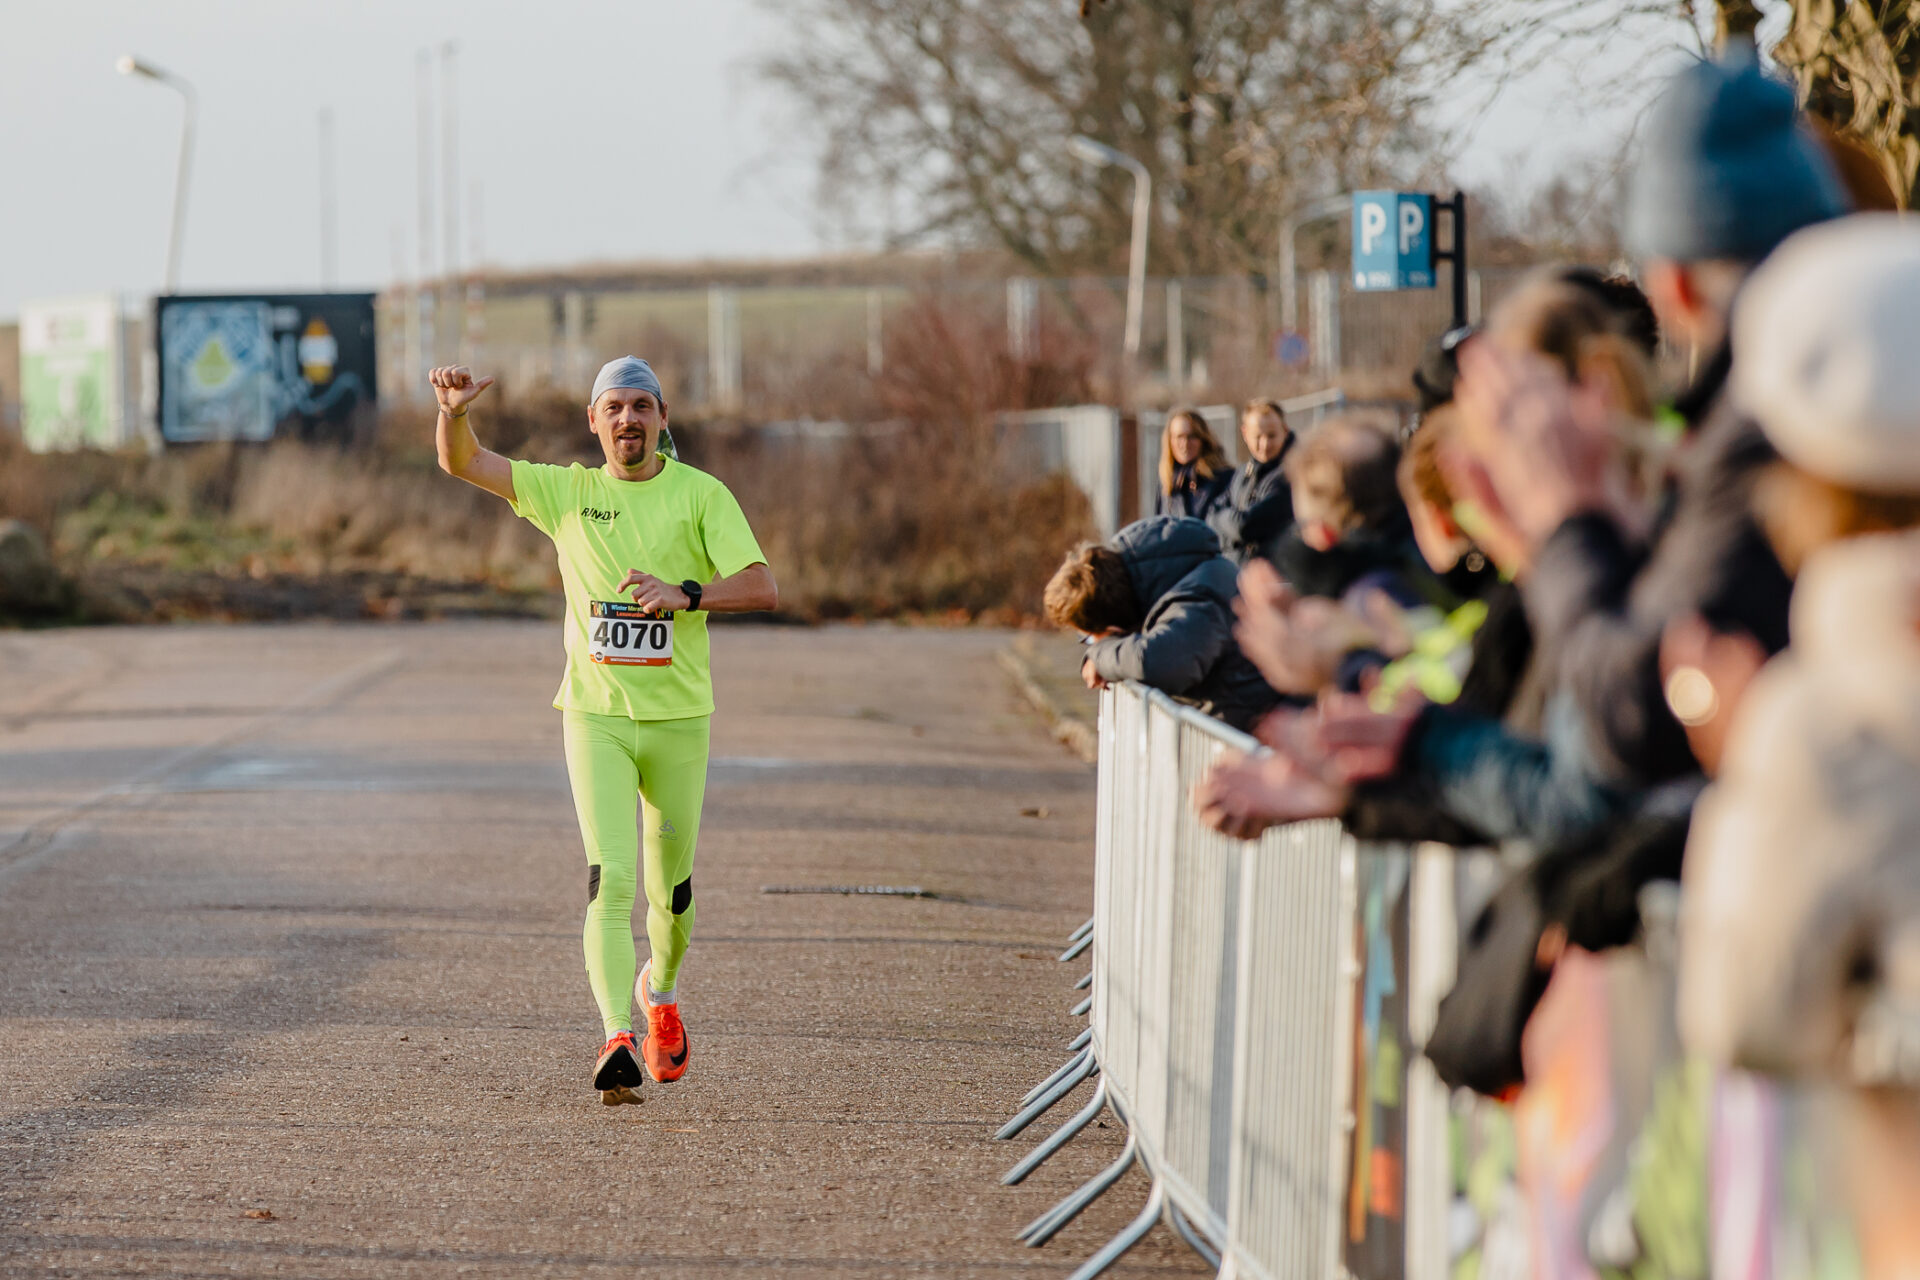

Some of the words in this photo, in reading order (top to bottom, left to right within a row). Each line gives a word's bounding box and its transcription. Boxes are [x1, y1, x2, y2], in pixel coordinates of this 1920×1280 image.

[1361, 202, 1387, 256] P
[1399, 201, 1424, 256] P
[593, 621, 668, 650] 4070
